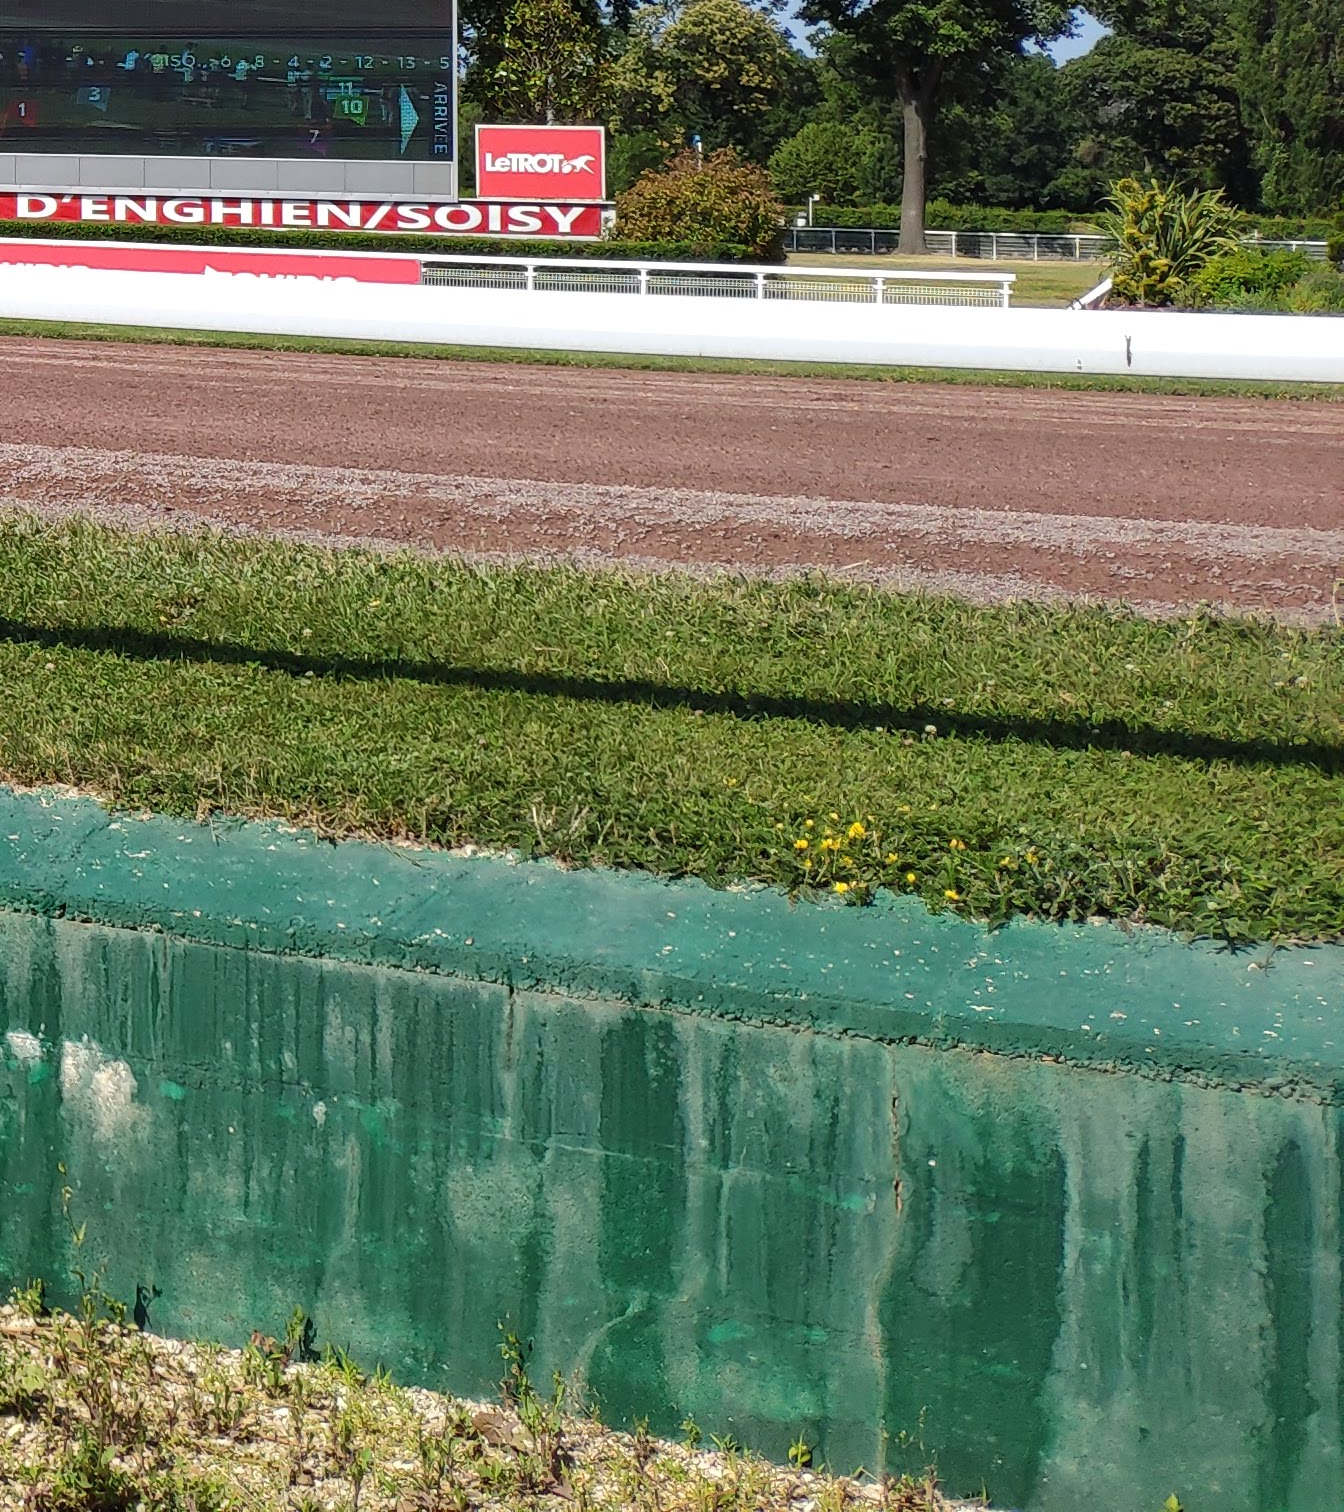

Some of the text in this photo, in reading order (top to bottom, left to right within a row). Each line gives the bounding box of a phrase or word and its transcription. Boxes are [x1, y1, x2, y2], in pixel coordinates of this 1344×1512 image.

[88, 87, 101, 101] 3
[18, 102, 27, 117] 1
[485, 152, 565, 174] LeTROT
